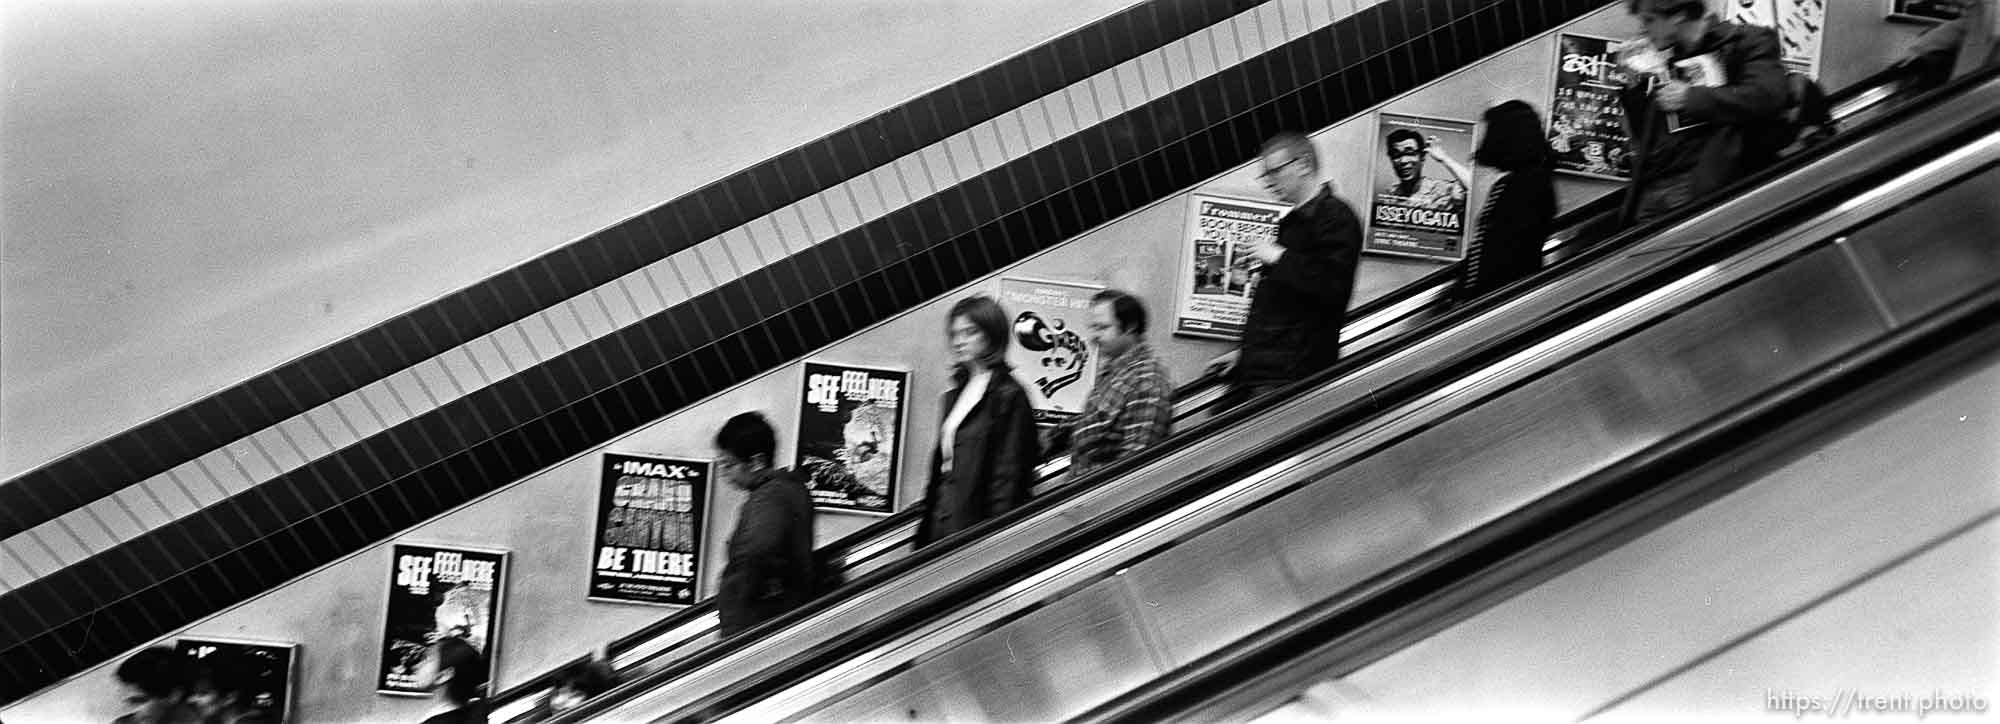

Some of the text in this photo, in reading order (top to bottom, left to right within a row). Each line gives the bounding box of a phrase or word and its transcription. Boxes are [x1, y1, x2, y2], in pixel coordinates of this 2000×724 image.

[1202, 202, 1280, 223] Frommer's
[1376, 205, 1413, 223] ISSEY
[1411, 210, 1459, 228] OGATA
[1200, 218, 1279, 236] BOOK BEFORE
[807, 374, 841, 404] SEE
[840, 370, 869, 393] FEEL
[623, 461, 687, 478] IMAX
[397, 555, 432, 586] SEE
[432, 552, 462, 574] FEEL
[597, 547, 694, 576] BE THERE
